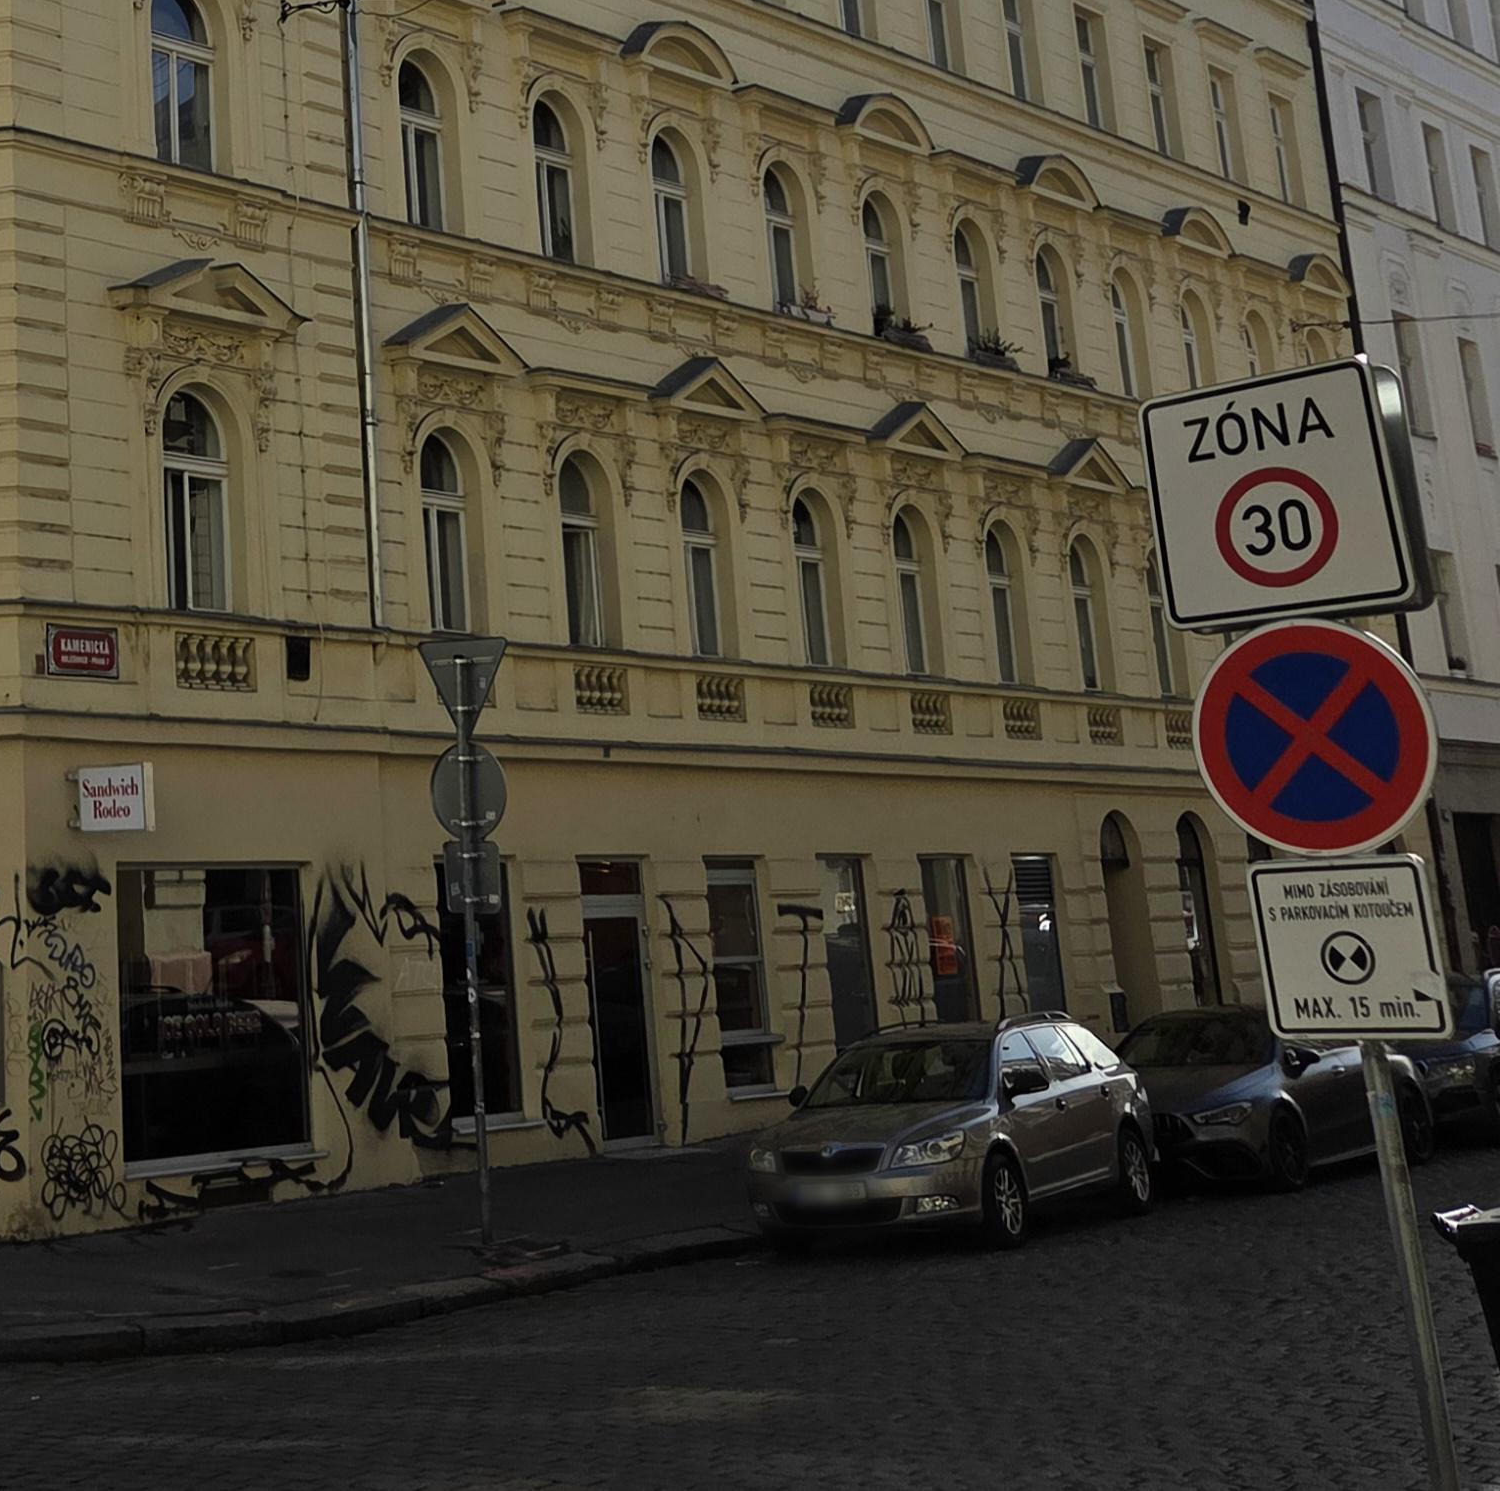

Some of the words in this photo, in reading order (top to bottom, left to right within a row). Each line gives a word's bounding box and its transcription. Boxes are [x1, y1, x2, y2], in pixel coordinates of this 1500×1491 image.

[1182, 396, 1335, 463] ZÓNA
[1242, 498, 1312, 556] 30
[60, 636, 110, 655] KAMENICKÁ
[82, 775, 139, 798] Sandwich
[93, 798, 131, 820] Rodeo
[1283, 884, 1314, 900] MIMO
[1320, 876, 1389, 899] ZÁSOBOVÁNÍ
[1268, 907, 1277, 922] S
[1281, 901, 1350, 922] PARKOVACÍM
[1355, 898, 1414, 919] KOTOUČEM
[1294, 996, 1342, 1018] MAX.
[1349, 996, 1371, 1018] 15
[1379, 996, 1421, 1018] min.
